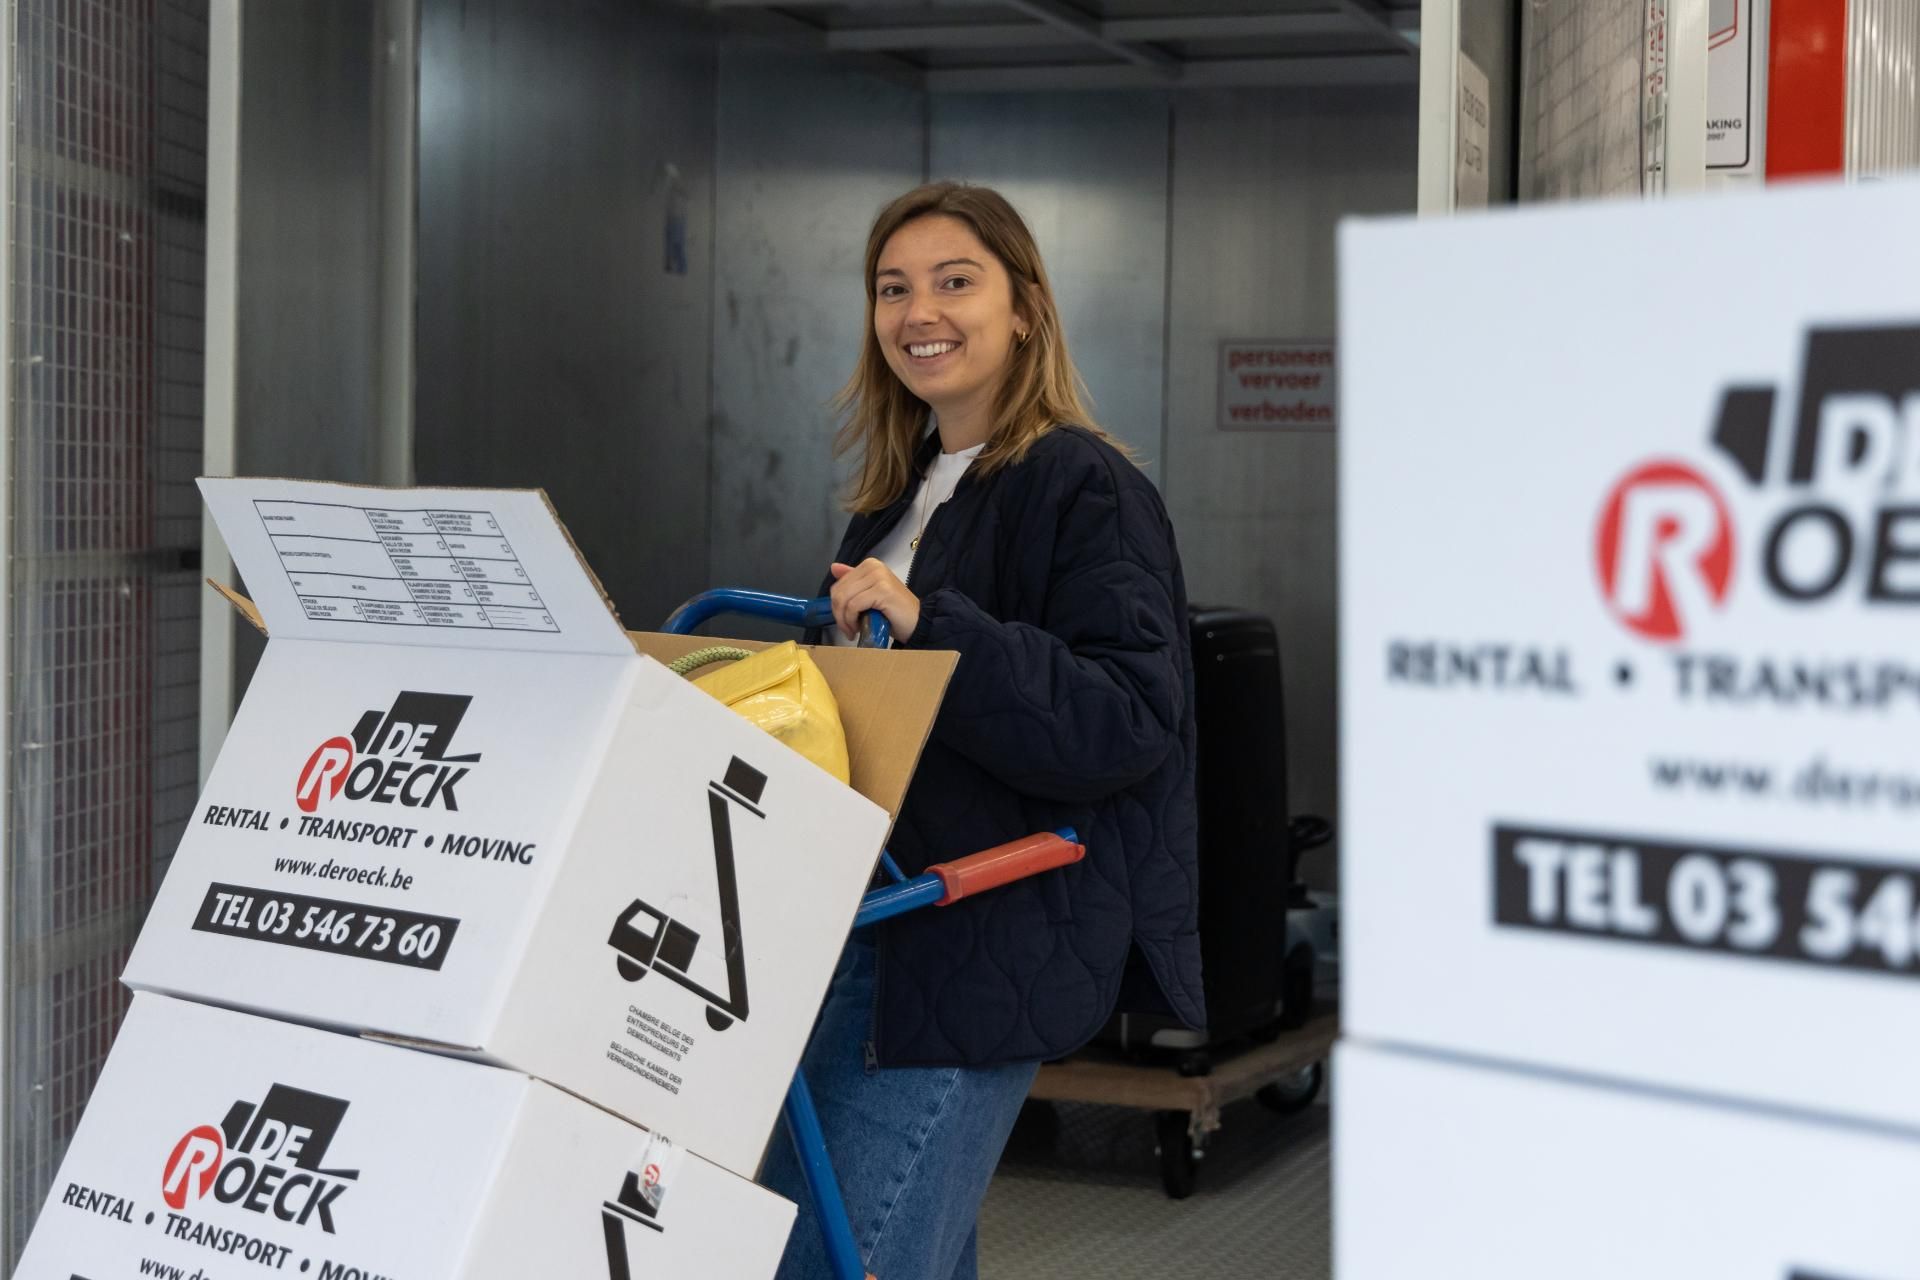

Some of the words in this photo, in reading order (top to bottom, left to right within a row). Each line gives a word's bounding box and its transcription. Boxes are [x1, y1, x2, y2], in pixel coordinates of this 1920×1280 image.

[1229, 350, 1334, 371] personen
[1240, 374, 1321, 389] vervoer
[1229, 399, 1334, 421] verboden
[1811, 394, 1920, 497] D
[1386, 639, 1578, 695] RENTAL
[1670, 651, 1920, 712] TRANSP
[379, 722, 438, 760] DE
[296, 744, 471, 812] ROECK
[203, 805, 271, 832] RENTAL
[298, 815, 418, 849] TRANSPORT
[440, 833, 537, 866] MOVING
[274, 857, 414, 891] www.deroeck.be
[210, 892, 255, 929] TEL
[257, 900, 295, 934] 03
[295, 906, 355, 944] 546
[355, 915, 396, 952] 73
[398, 925, 441, 959] 60
[1514, 838, 1658, 934] TEL
[1667, 853, 1781, 950] 03
[1798, 868, 1920, 966] 54
[626, 1015, 680, 1049] ENTREPRENEURS
[680, 1044, 690, 1055] DE
[626, 1027, 682, 1061] DEMENAGEMENTS
[629, 1004, 660, 1026] CHAMBRE
[660, 1021, 681, 1039] BELGE
[681, 1034, 695, 1046] DES
[610, 1040, 646, 1065] BELGISCHE
[669, 1073, 682, 1085] DER
[249, 1118, 313, 1167] DE
[163, 1134, 348, 1235] ROECK
[62, 1182, 135, 1224] RENTAL
[164, 1213, 293, 1270] TRANSPORT
